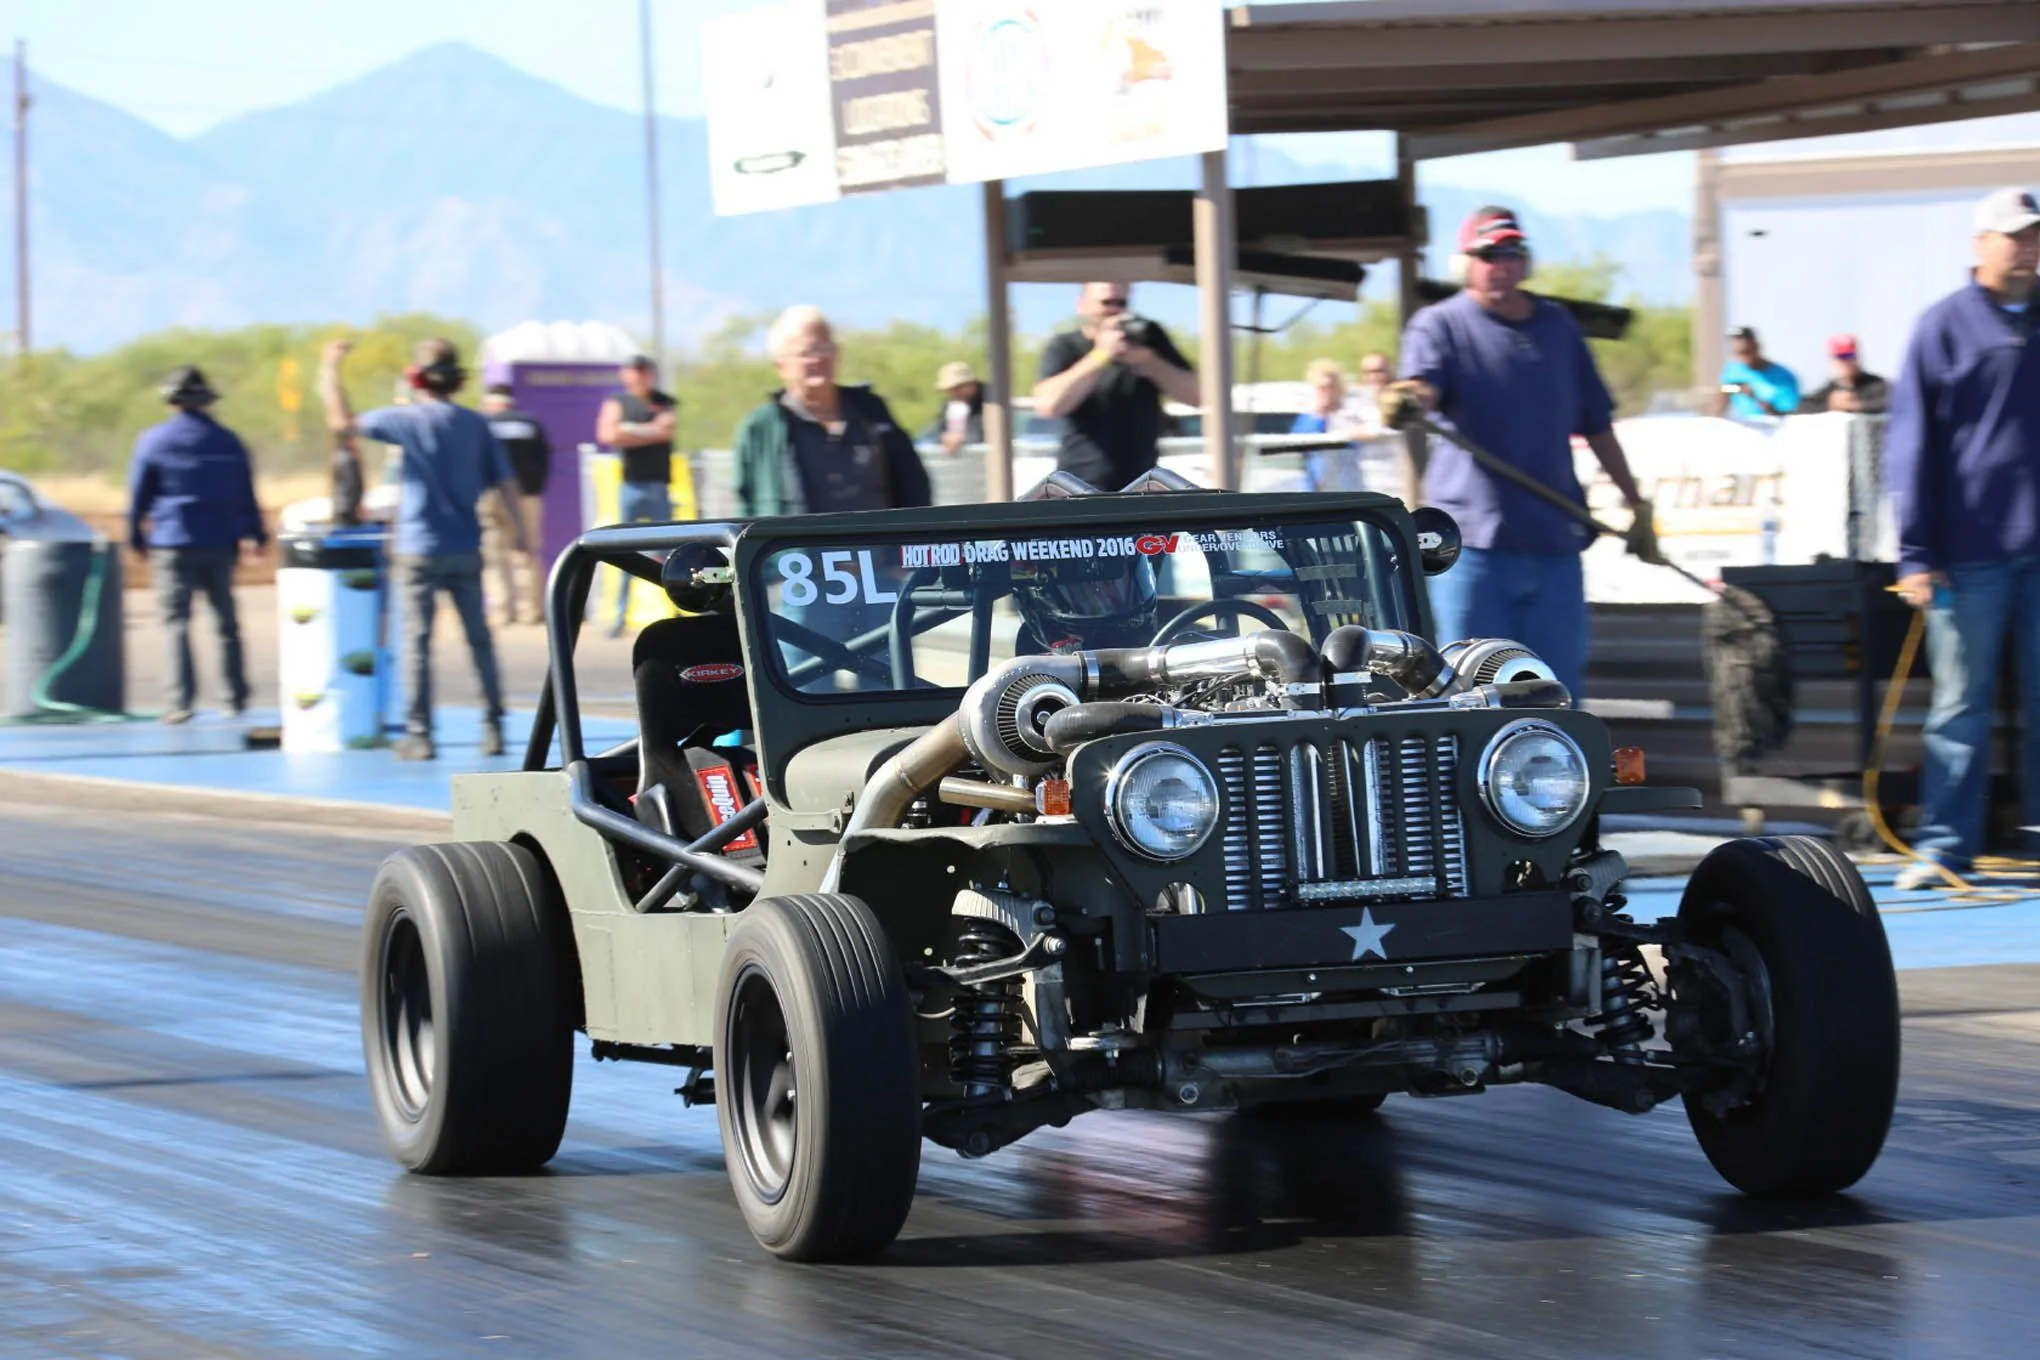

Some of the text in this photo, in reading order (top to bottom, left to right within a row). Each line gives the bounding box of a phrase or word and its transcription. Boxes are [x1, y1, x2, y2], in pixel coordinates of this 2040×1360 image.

[1136, 534, 1180, 556] GV
[1183, 530, 1277, 543] GEAR VENRS
[901, 537, 1137, 568] HOT ROD DRAG WEEKEND 2016
[778, 550, 898, 606] 85L
[686, 667, 738, 677] KIRKEY
